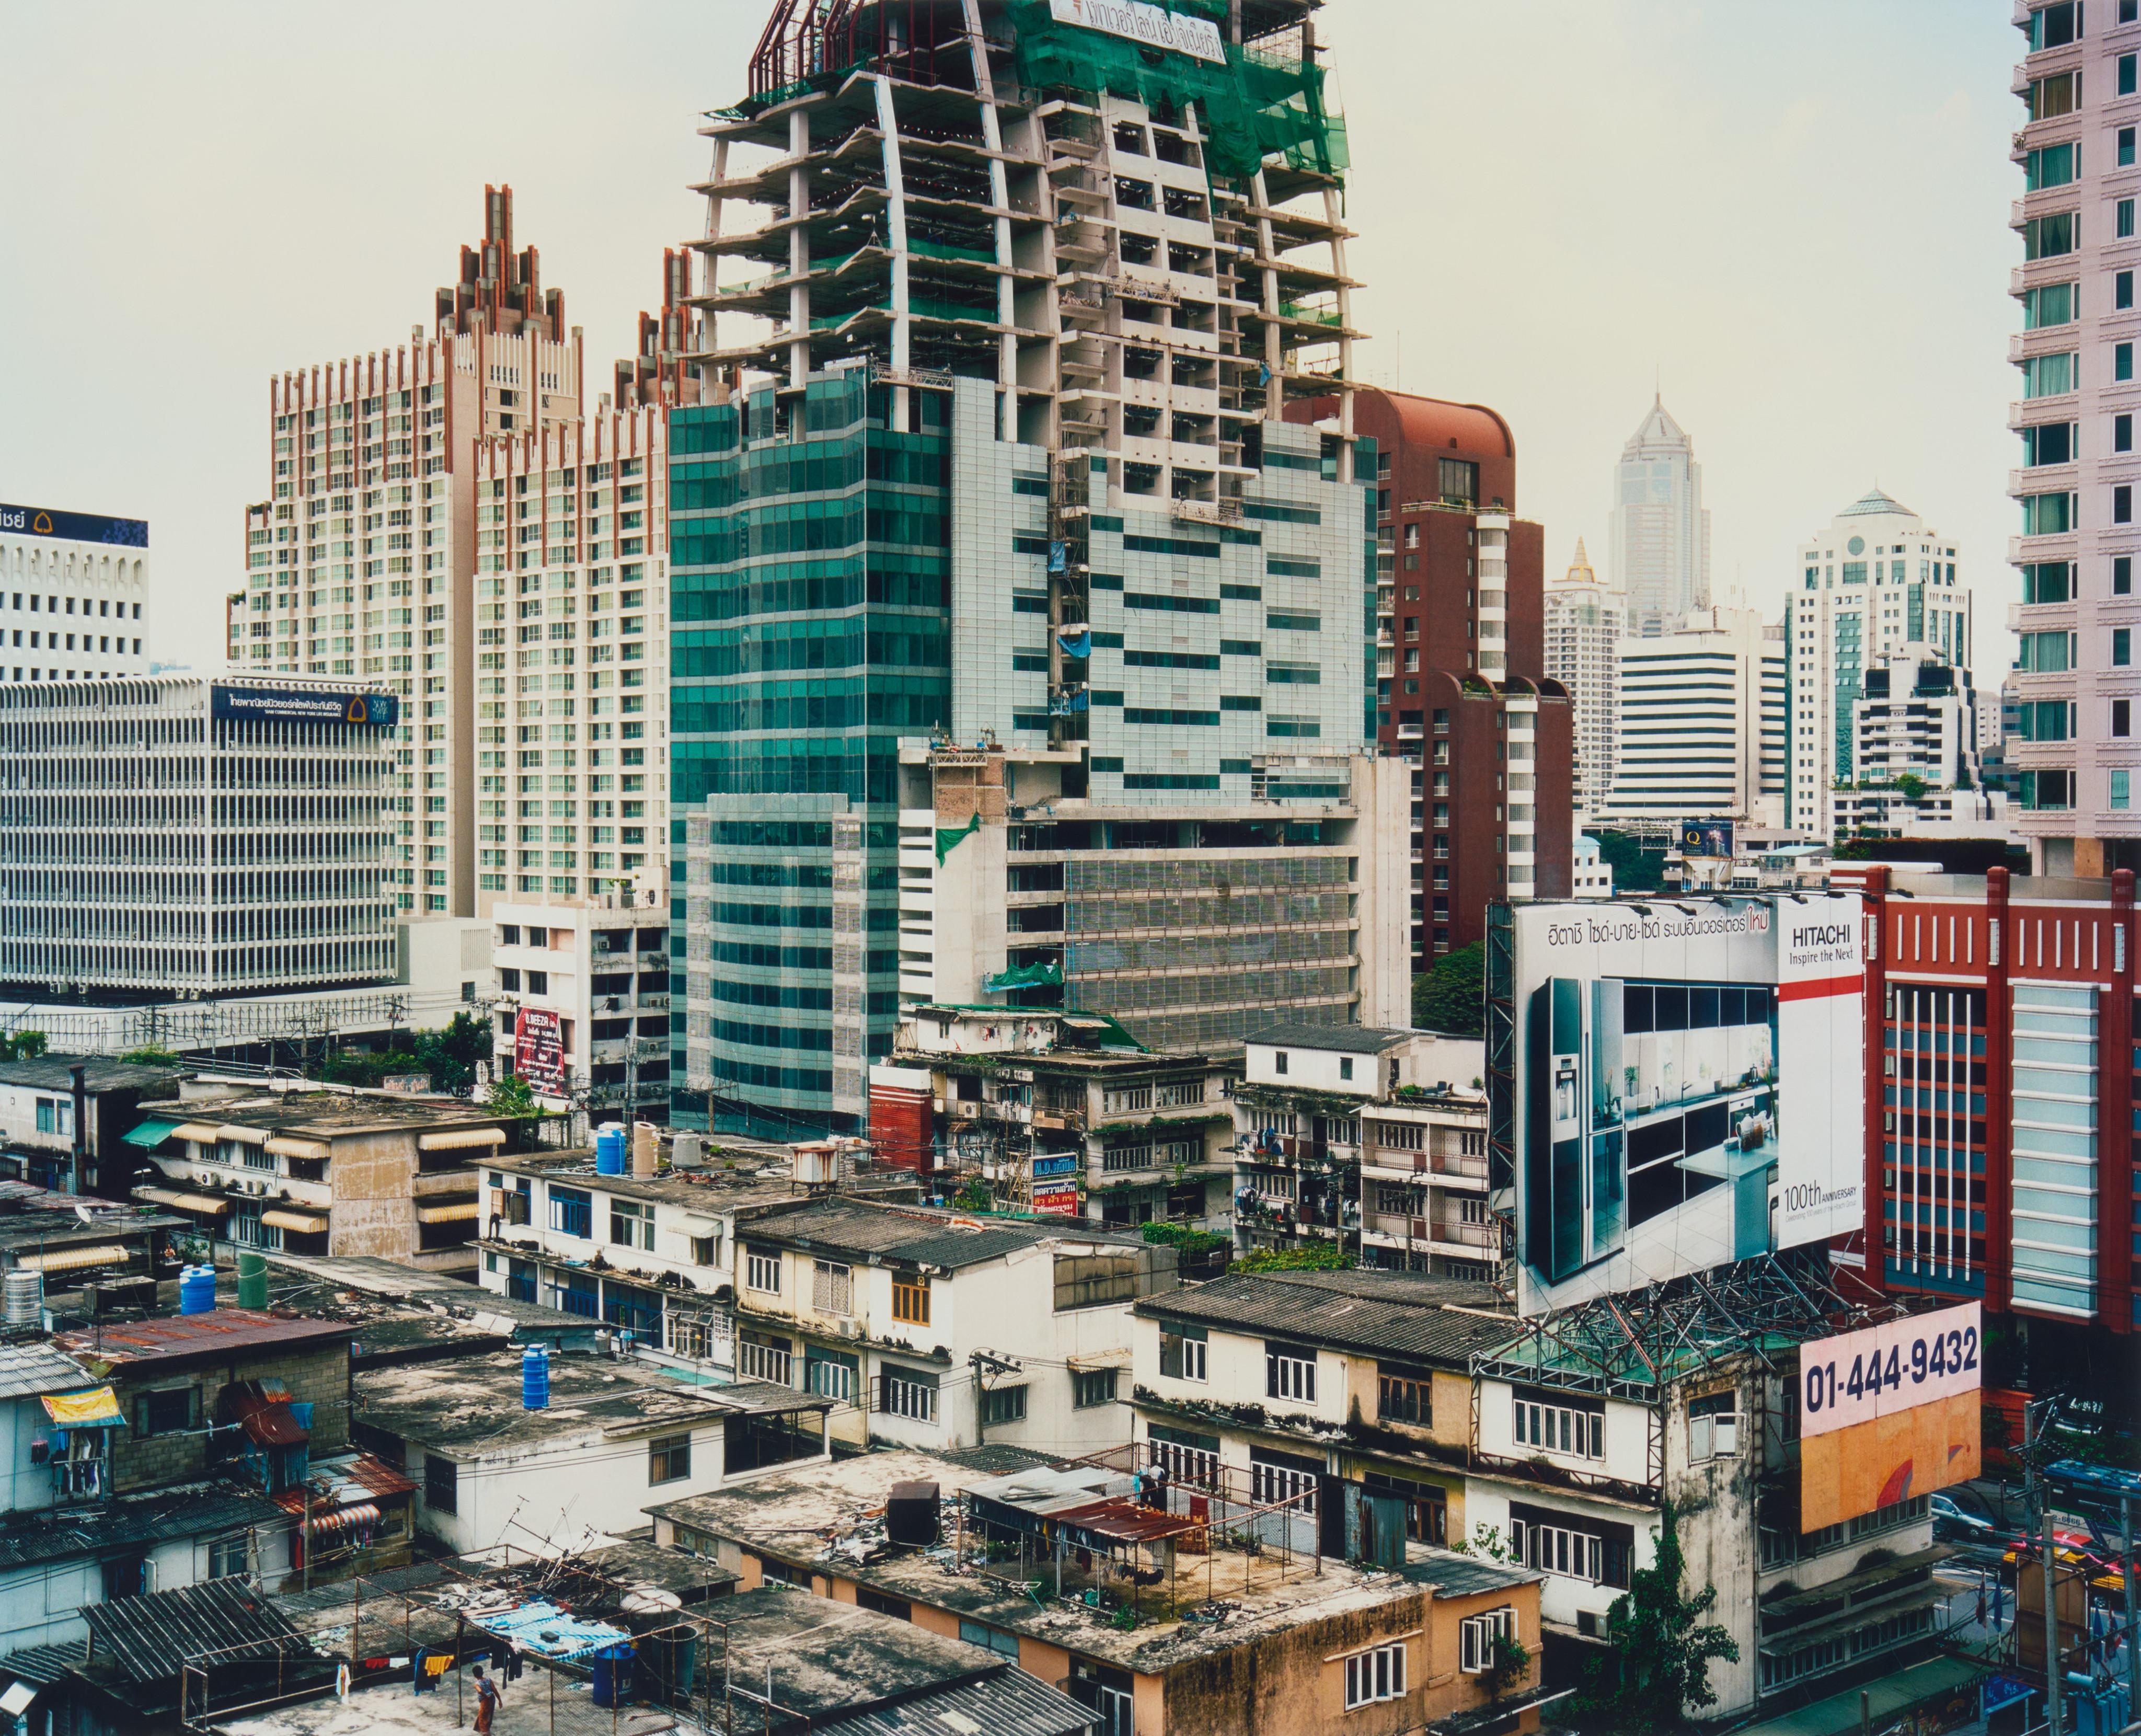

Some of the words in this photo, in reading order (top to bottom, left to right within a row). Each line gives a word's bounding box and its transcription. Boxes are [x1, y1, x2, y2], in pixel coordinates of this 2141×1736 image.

[0, 508, 25, 528] ชย์
[1686, 831, 1701, 845] Q
[1748, 906, 1768, 930] ใหม่
[1793, 924, 1850, 947] HITACHI
[1790, 951, 1818, 967] Inspire
[1821, 949, 1833, 962] the
[1836, 945, 1853, 960] Next
[1034, 1182, 1076, 1196] ลดความอ้วน
[1048, 1195, 1059, 1204] ฝ้า
[1785, 1180, 1821, 1212] 100th
[1822, 1186, 1857, 1203] ANNIVERSARY
[1806, 1326, 1977, 1412] 01-444-9432
